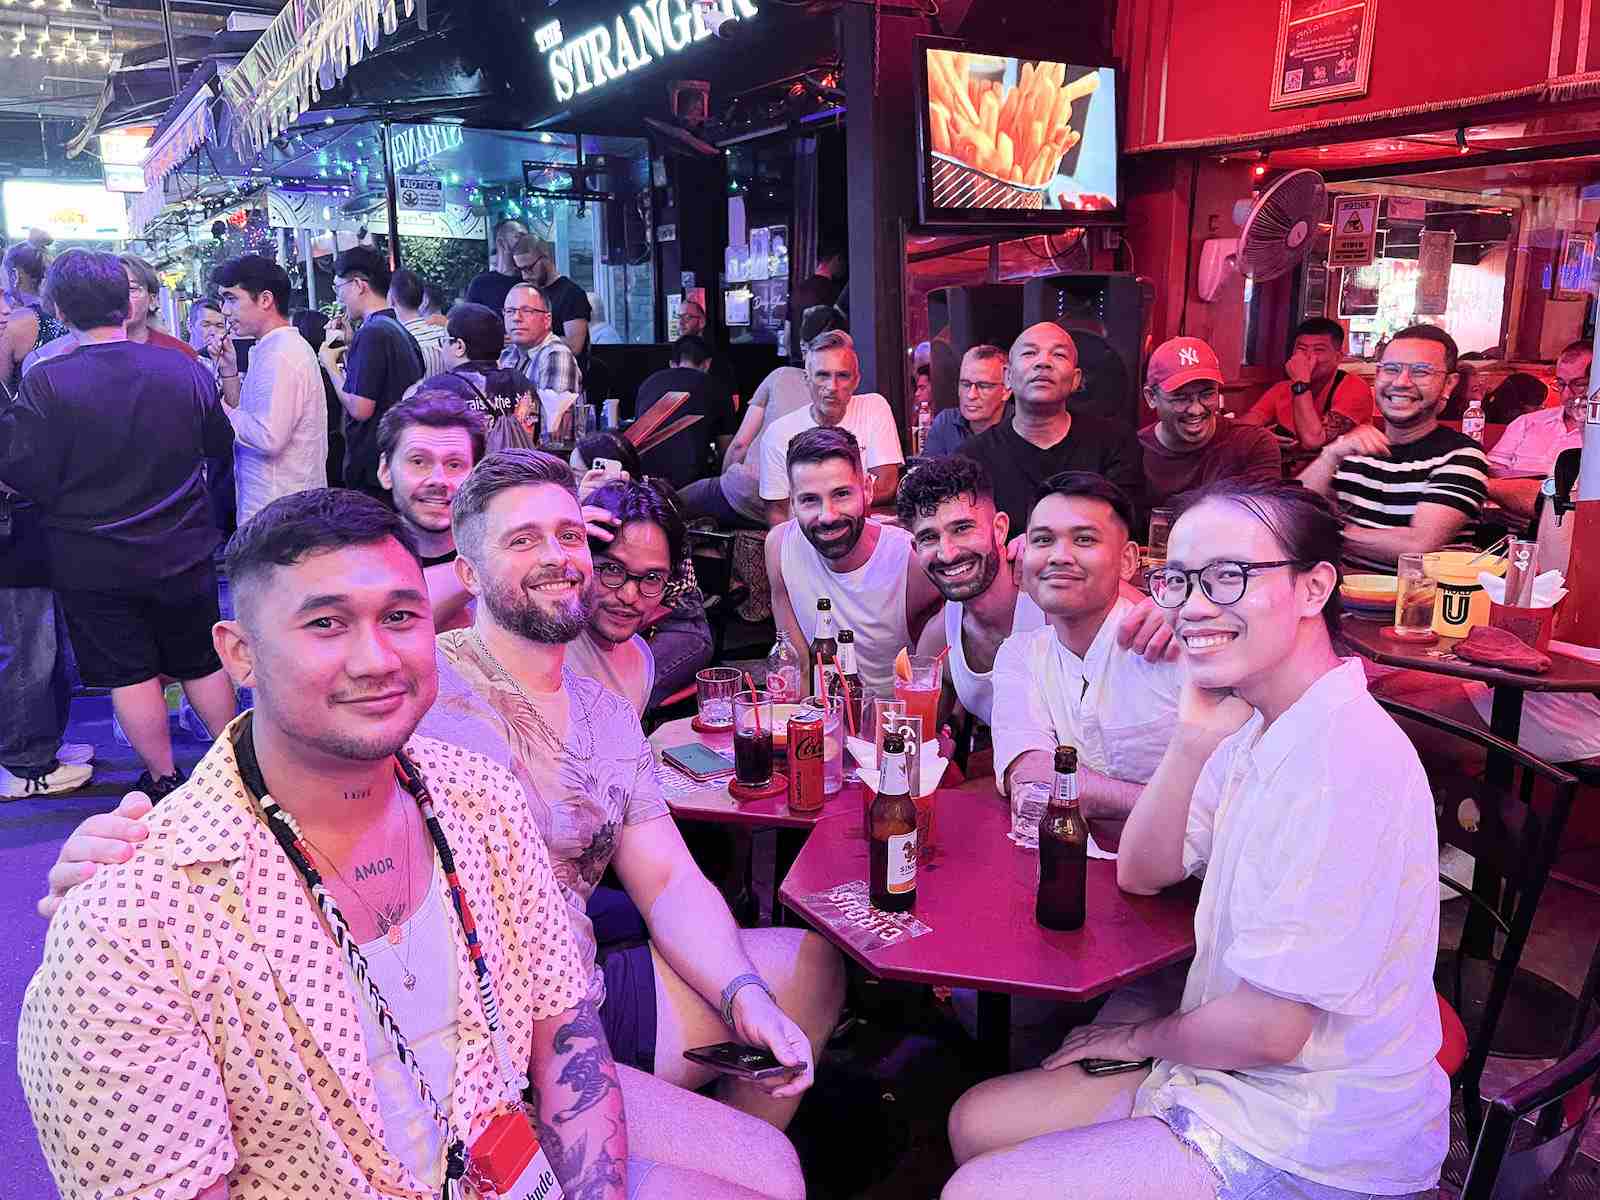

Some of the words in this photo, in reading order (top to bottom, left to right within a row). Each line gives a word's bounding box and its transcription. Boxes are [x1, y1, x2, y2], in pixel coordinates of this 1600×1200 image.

[534, 19, 564, 53] THE
[402, 180, 439, 189] NOTICE
[1178, 347, 1200, 366] NY
[1514, 550, 1530, 571] 46
[354, 857, 396, 882] AMOR
